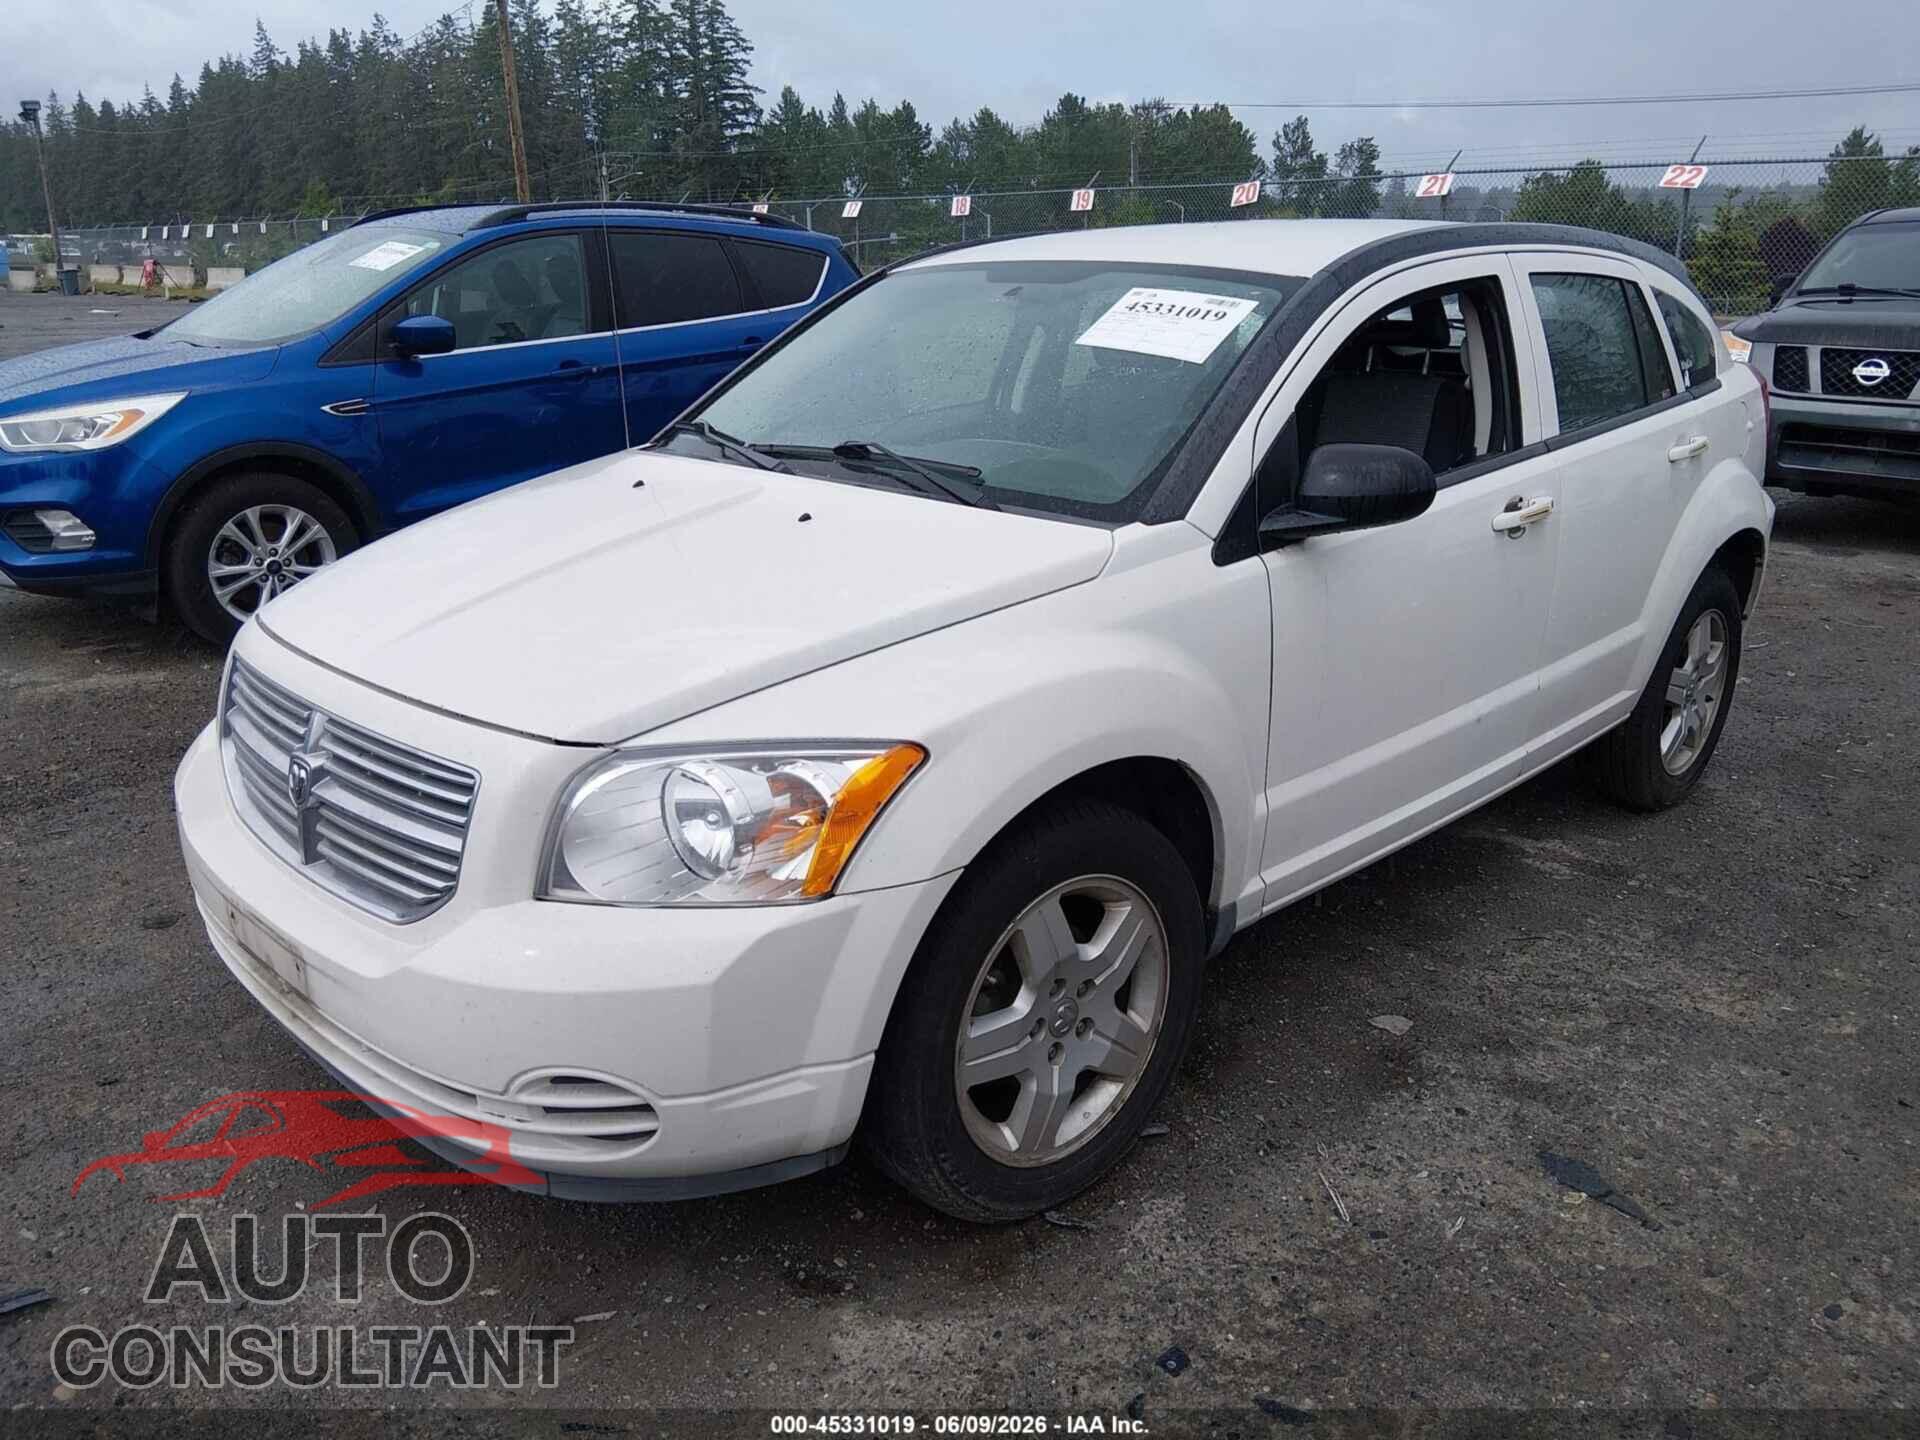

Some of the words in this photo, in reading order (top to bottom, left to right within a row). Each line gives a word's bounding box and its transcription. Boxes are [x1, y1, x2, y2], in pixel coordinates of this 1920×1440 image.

[1421, 175, 1449, 195] 21
[1663, 166, 1703, 186] 22
[1075, 191, 1091, 209] 19
[1234, 183, 1258, 203] 20
[955, 198, 968, 214] 18
[1125, 301, 1228, 322] 45331019
